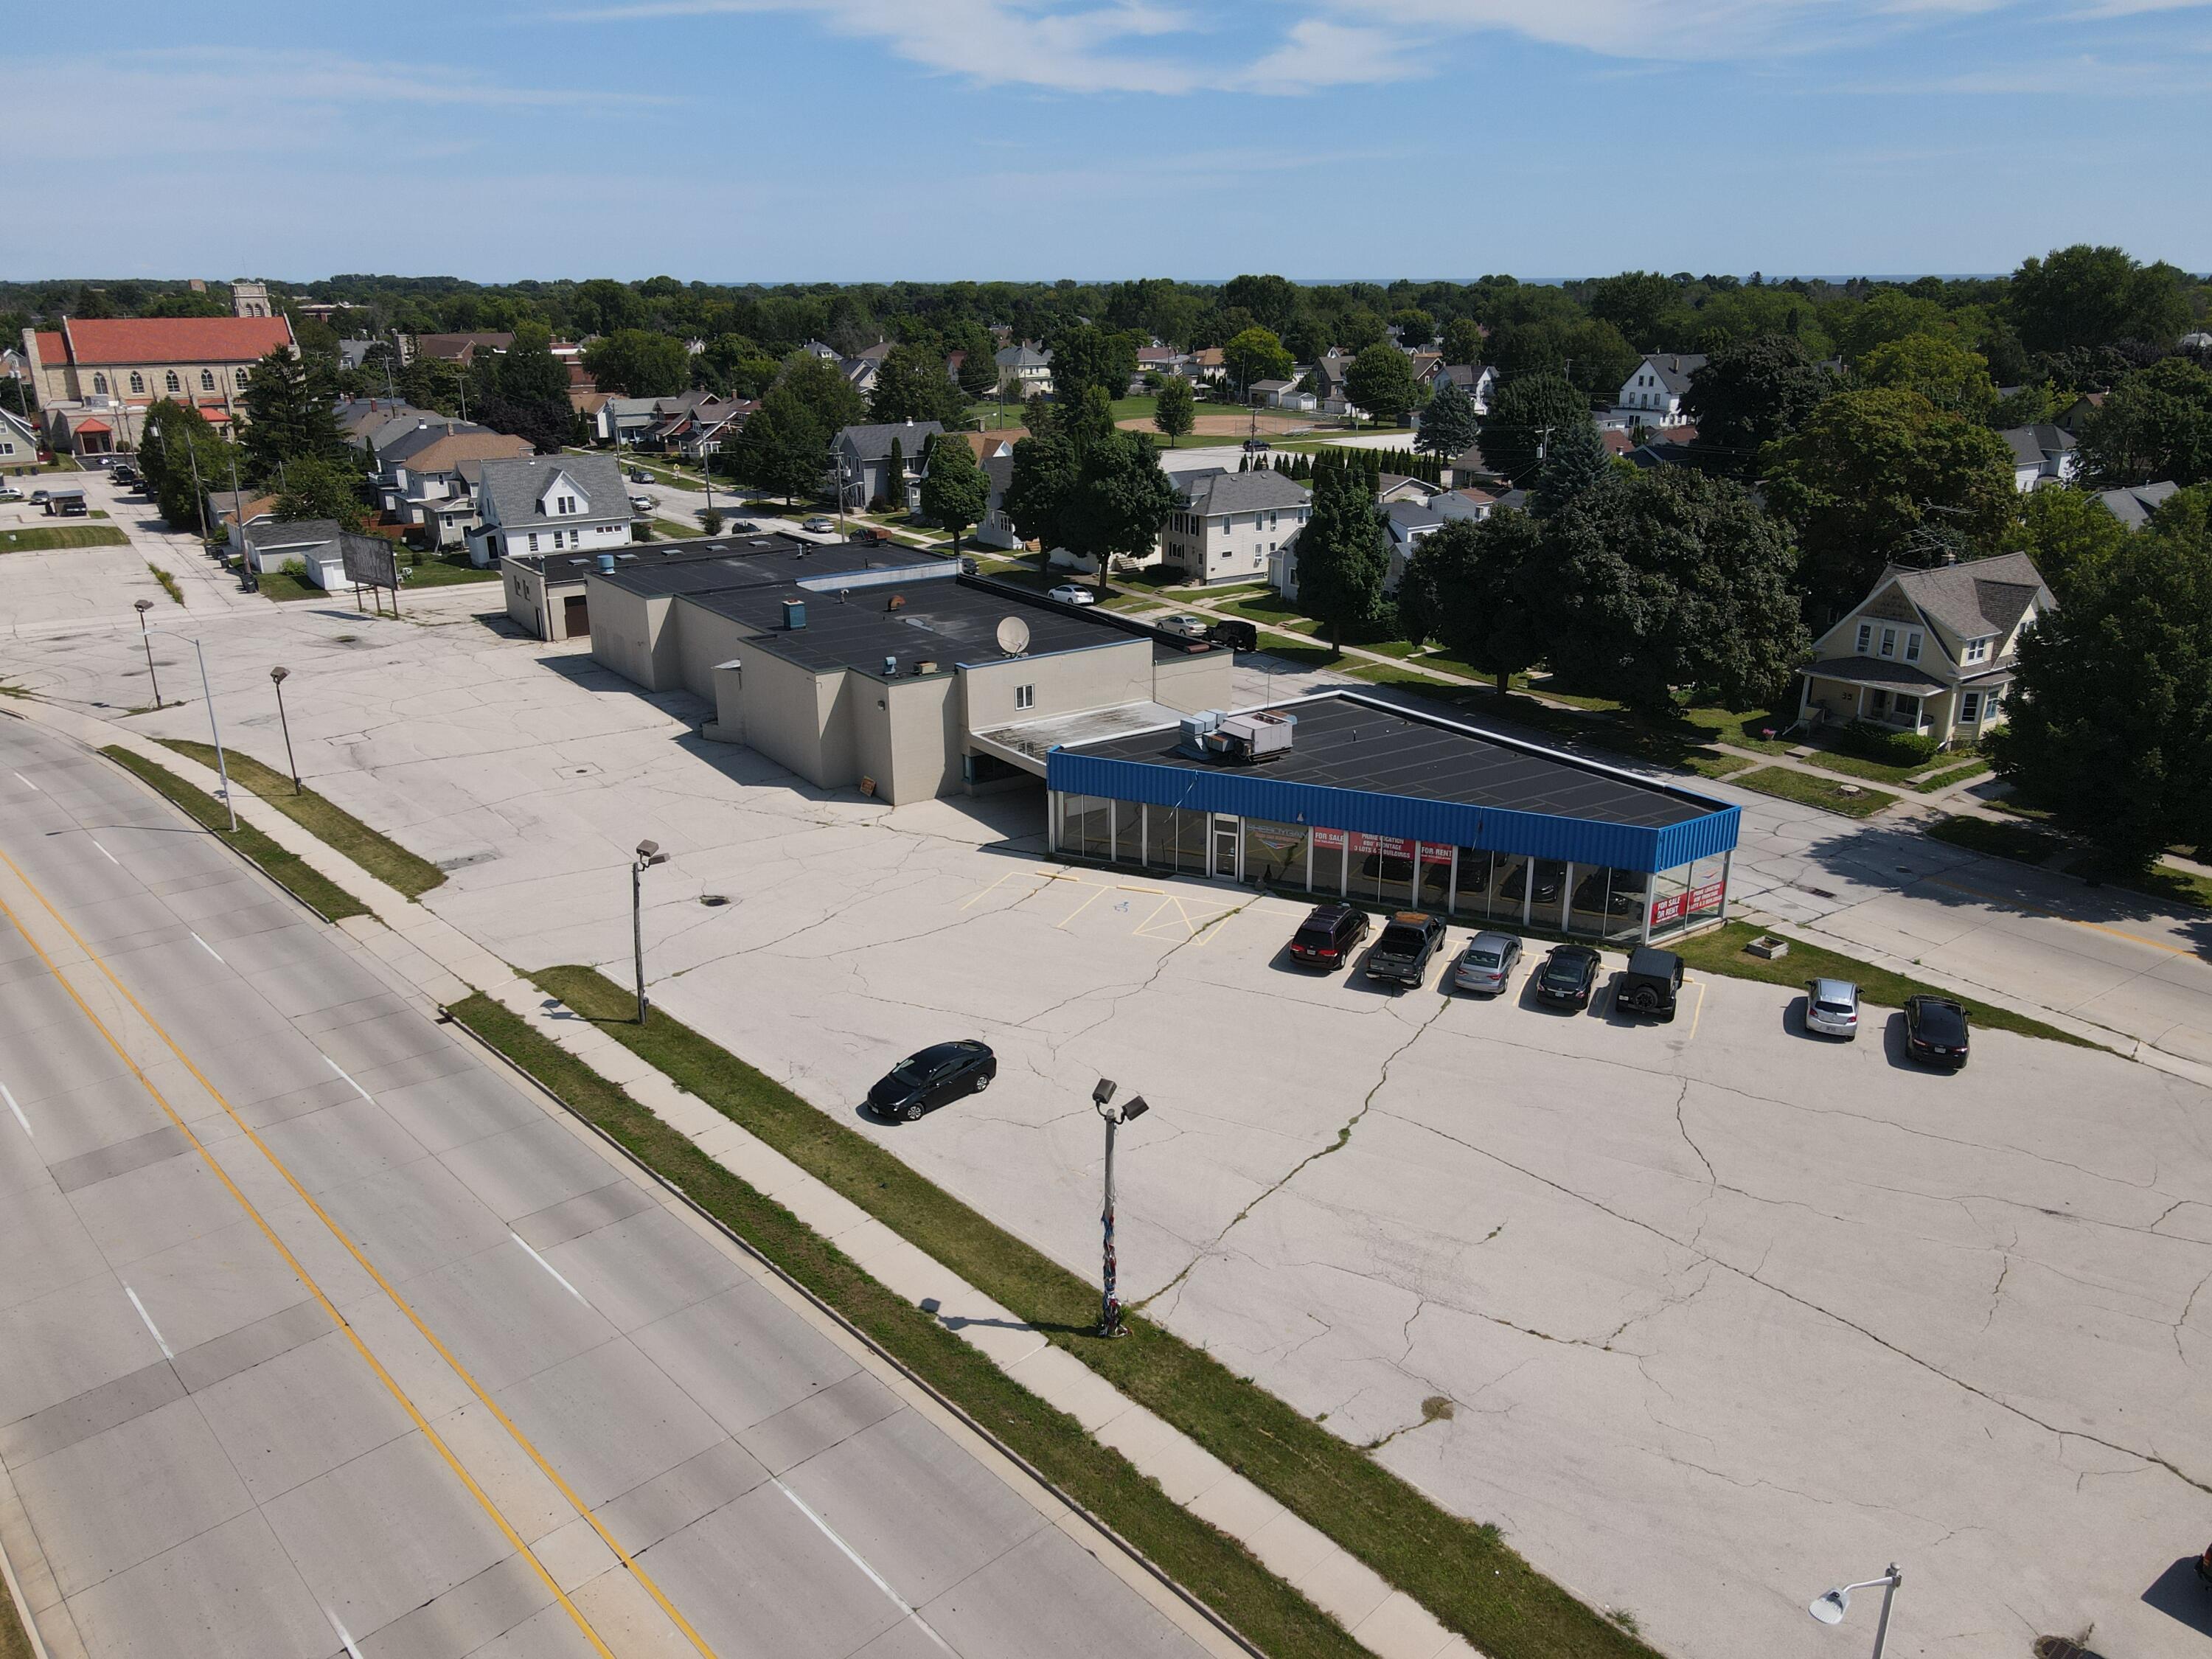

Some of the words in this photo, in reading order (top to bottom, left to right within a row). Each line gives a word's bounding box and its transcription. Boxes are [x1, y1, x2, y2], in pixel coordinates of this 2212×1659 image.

[1329, 833, 1344, 842] SALE
[1382, 849, 1411, 858] BUILDINGS
[1421, 846, 1433, 855] FOR
[1436, 849, 1452, 858] RENT
[1658, 901, 1667, 910] FOR
[1669, 897, 1680, 906] SALE
[1658, 911, 1665, 919] OR
[1666, 905, 1679, 916] RENT
